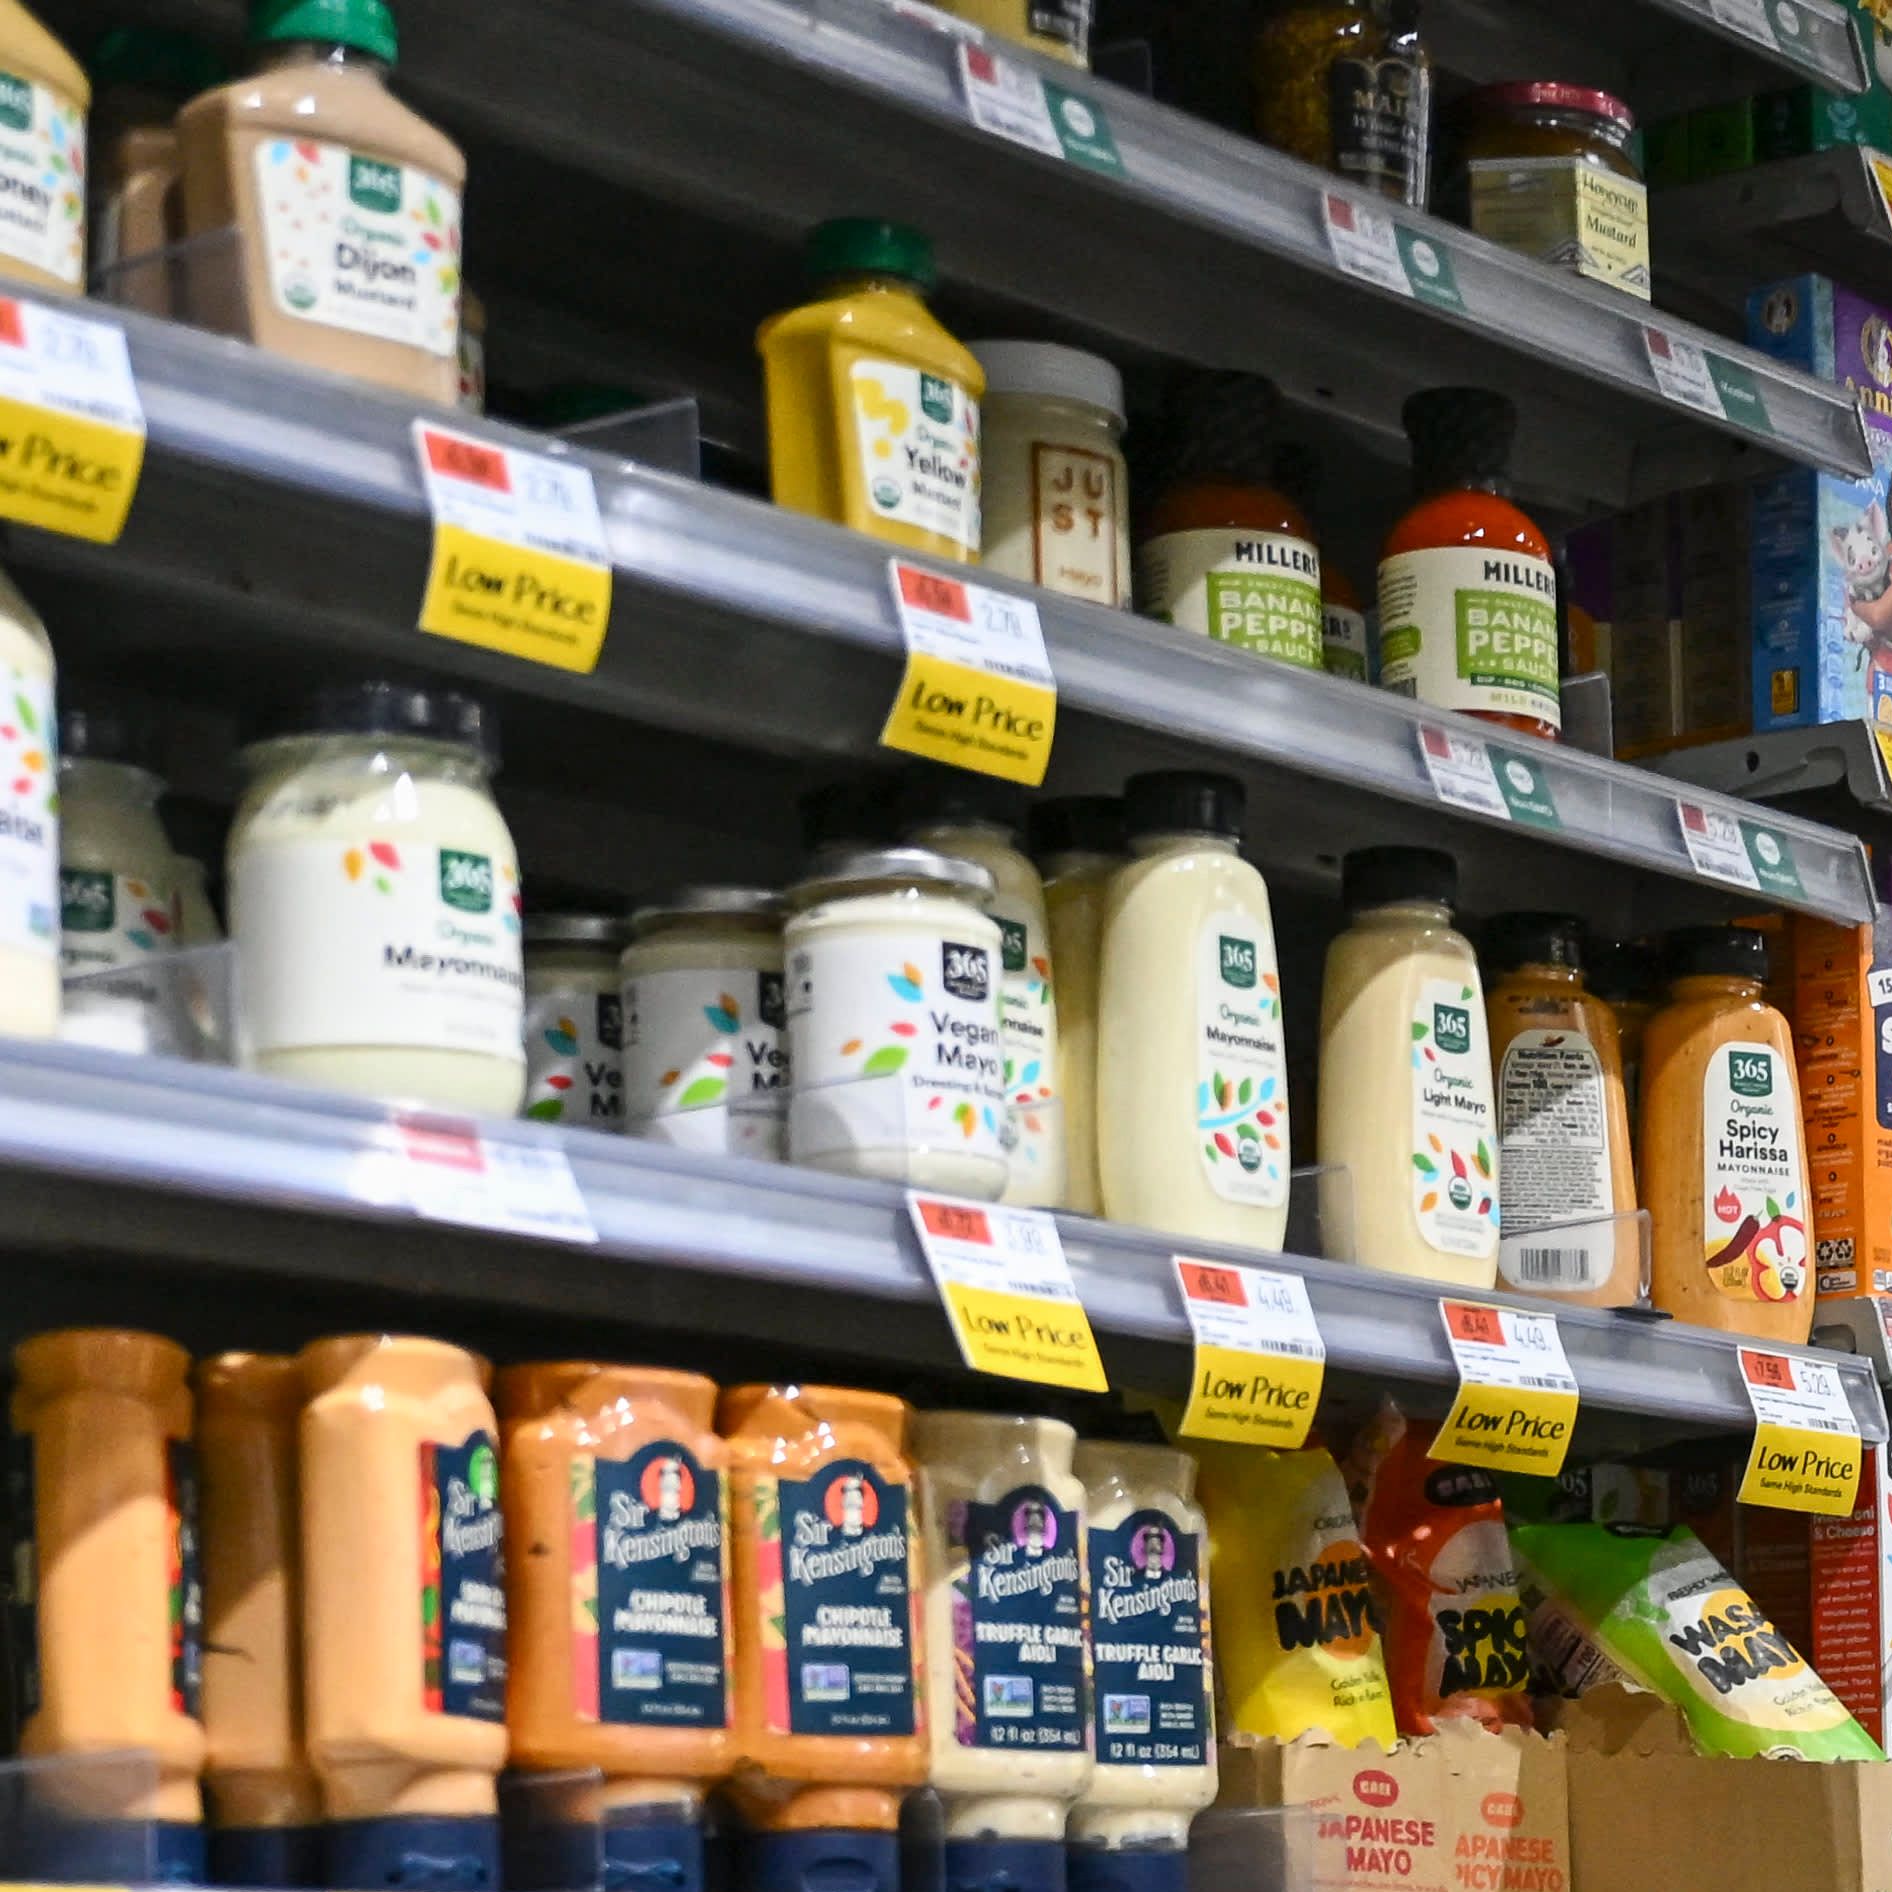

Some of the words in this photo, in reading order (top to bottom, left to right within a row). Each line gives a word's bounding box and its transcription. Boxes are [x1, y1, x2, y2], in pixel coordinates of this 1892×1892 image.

[1585, 214, 1639, 250] Mustard
[334, 243, 417, 288] Dijon
[29, 433, 124, 493] Price
[903, 447, 969, 490] Yellow
[444, 553, 506, 599] Low
[512, 577, 598, 628] Price
[1219, 611, 1321, 643] PEPPE
[911, 680, 970, 720] Low
[973, 697, 1045, 743] Price
[1222, 942, 1254, 971] 365
[930, 1010, 1000, 1046] Vegan
[1206, 1023, 1277, 1055] Mayonnaise
[1436, 1008, 1468, 1038] 365
[936, 1043, 998, 1080] Mayo
[1733, 1058, 1768, 1080] 365
[1423, 1087, 1452, 1112] Light
[1454, 1092, 1488, 1116] Mayo
[1730, 1099, 1774, 1117] Organic
[1726, 1118, 1780, 1145] Spicy
[1719, 1139, 1788, 1164] Harissa
[1717, 1162, 1790, 1178] MAYONNAISE
[964, 1305, 1013, 1338] Low
[1016, 1315, 1087, 1350] Price
[1201, 1368, 1244, 1402] Low
[1249, 1374, 1310, 1412] Price
[1799, 1366, 1837, 1397] 5.29
[1455, 1405, 1501, 1435] Low
[1504, 1408, 1565, 1442] Price
[1757, 1443, 1797, 1474] Low
[1800, 1448, 1853, 1482] Price
[1759, 1476, 1784, 1490] Same
[1785, 1479, 1802, 1495] High
[1803, 1482, 1843, 1500] Standards
[610, 1493, 647, 1528] Sir
[794, 1511, 832, 1545] Sir
[791, 1529, 907, 1586] Kensington's
[984, 1536, 1014, 1564] Sir
[1103, 1558, 1134, 1588] Sir
[1096, 1642, 1158, 1664] TRUFFLE
[1161, 1645, 1202, 1666] GARLIC
[1137, 1662, 1175, 1682] AIOLI
[1318, 1815, 1435, 1847] JAPANESE
[1346, 1845, 1411, 1876] MAYO
